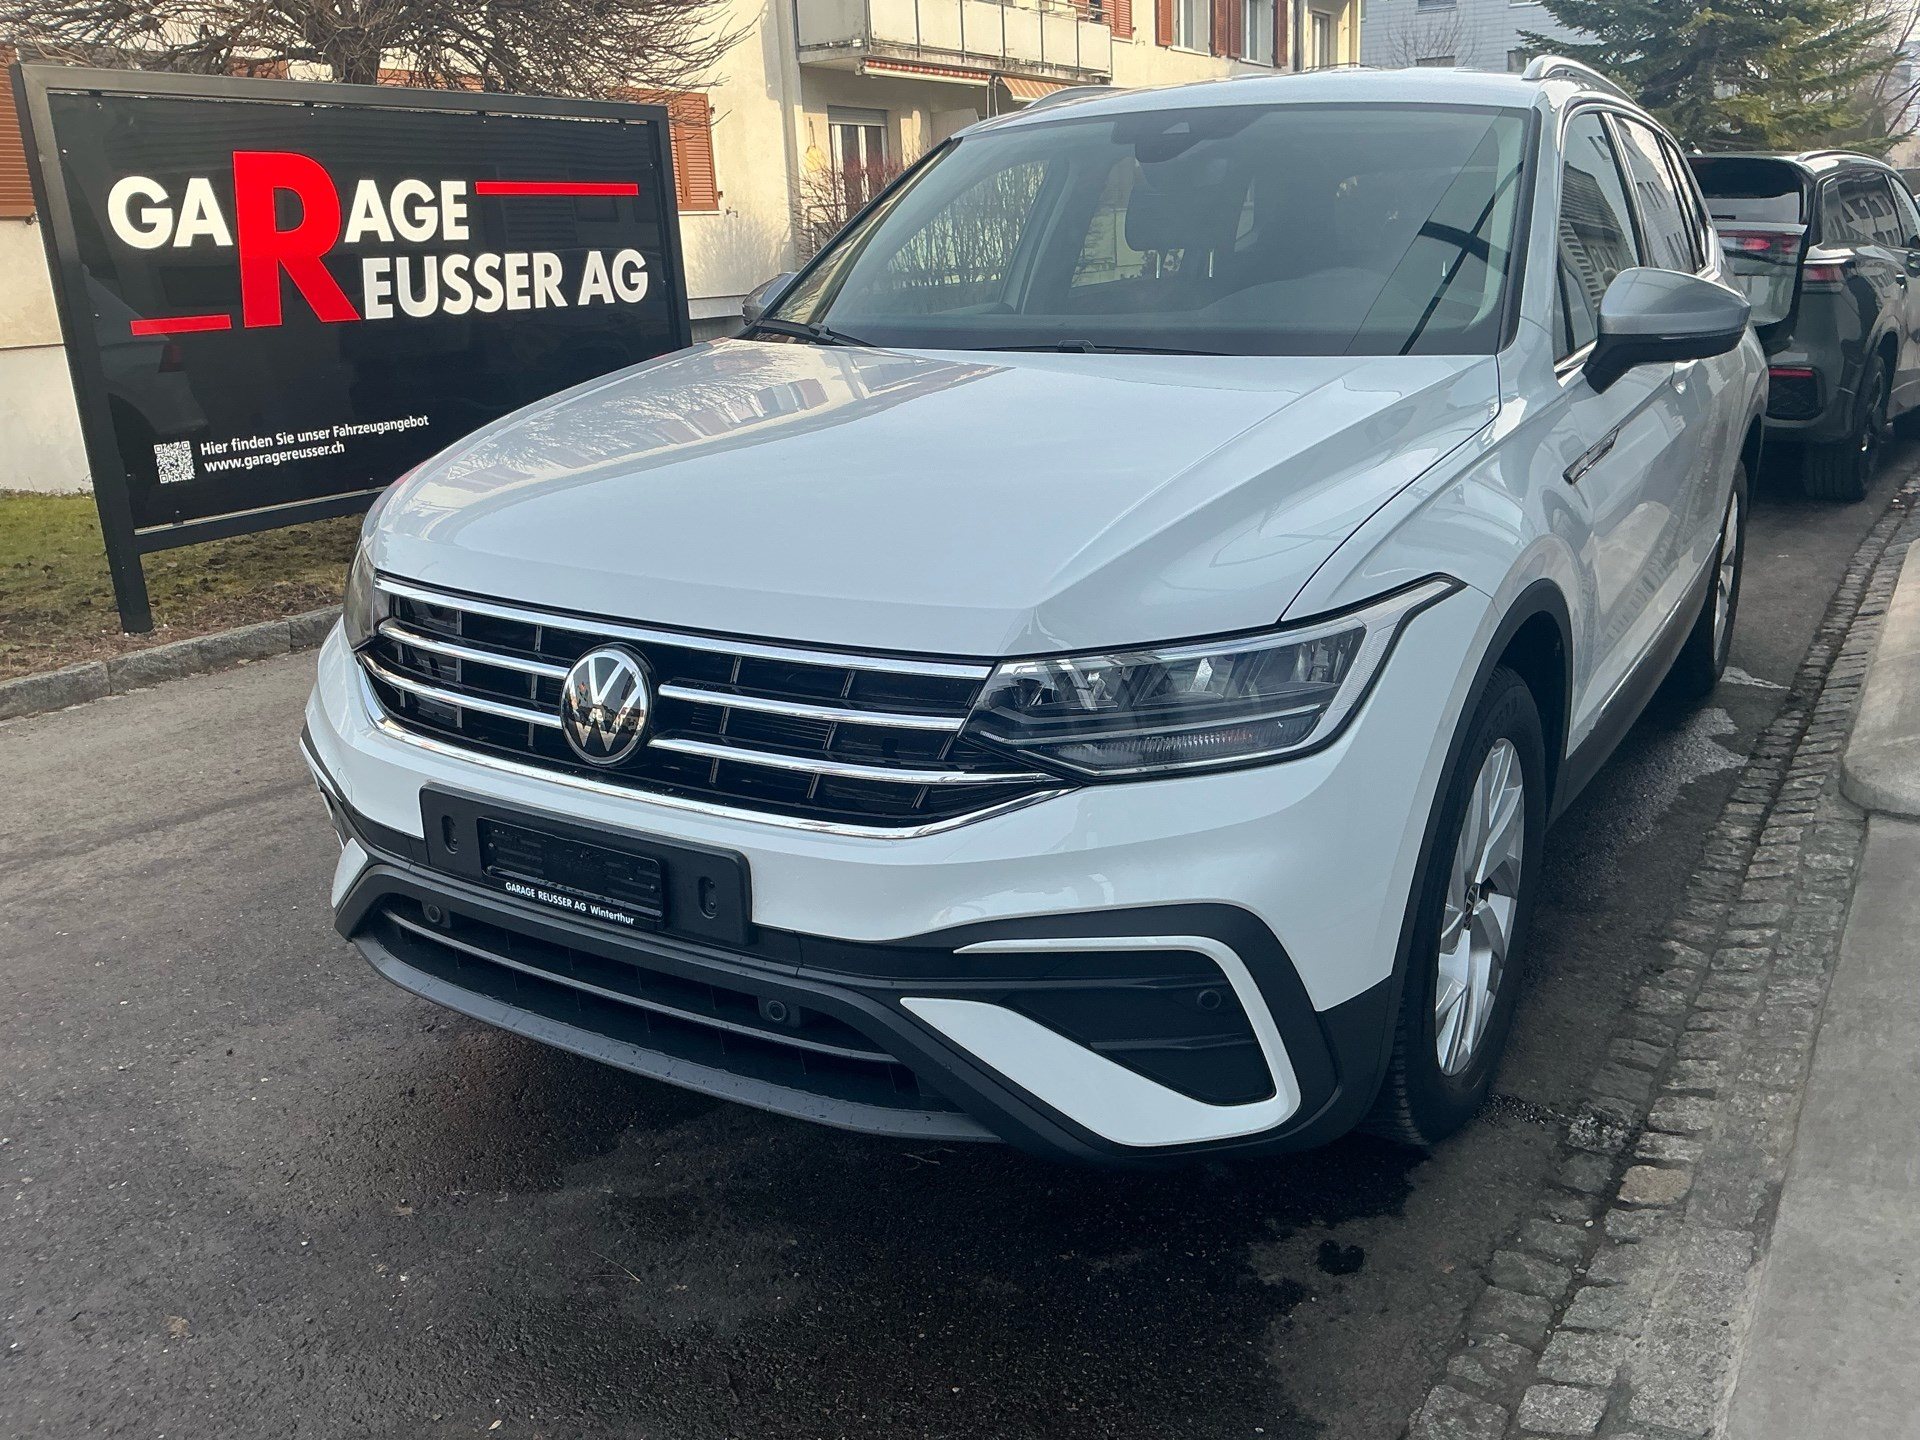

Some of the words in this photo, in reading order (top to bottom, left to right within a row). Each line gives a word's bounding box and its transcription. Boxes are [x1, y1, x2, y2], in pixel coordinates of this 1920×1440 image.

[107, 151, 469, 328] GARAGE
[578, 249, 648, 306] AG
[200, 441, 228, 456] Hier
[231, 435, 273, 452] finden
[275, 431, 295, 446] Sie
[297, 428, 331, 443] unser
[332, 415, 430, 438] Fahrzeugangebot
[204, 441, 346, 473] www.garagereusser.ch
[505, 881, 536, 898] GARAGE
[537, 890, 573, 908] REUSSER
[574, 900, 587, 912] AG
[590, 904, 635, 925] Winterthur
